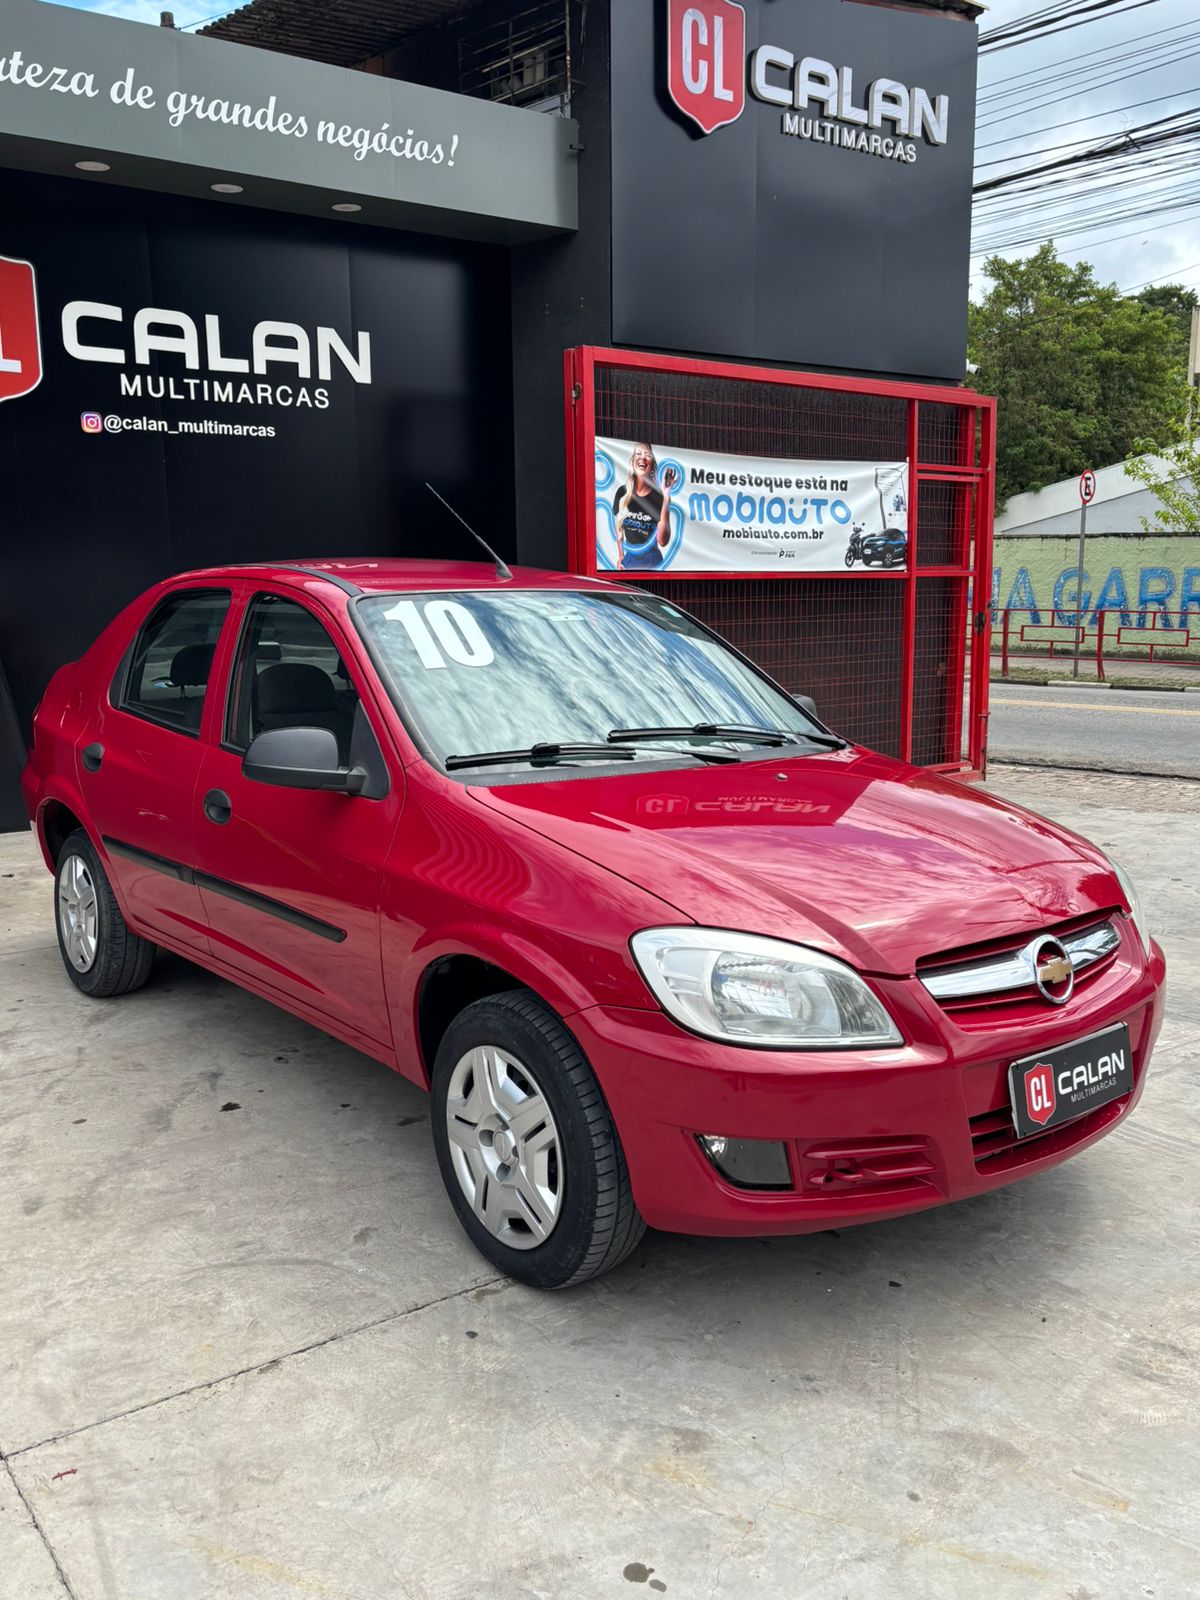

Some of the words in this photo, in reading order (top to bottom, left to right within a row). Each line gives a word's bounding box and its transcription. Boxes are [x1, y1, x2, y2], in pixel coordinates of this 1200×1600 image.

[682, 8, 733, 102] CL
[110, 68, 156, 109] de
[166, 91, 308, 137] grandes
[317, 123, 459, 167] negócios!
[753, 45, 949, 145] CALAN
[783, 112, 917, 163] MULTIMARCAS
[61, 301, 372, 384] CALAN
[120, 373, 330, 409] MULTIMARCAS
[103, 414, 276, 438] @calan_multimarcas
[691, 468, 726, 485] Meu
[729, 474, 793, 493] estoque
[795, 477, 827, 490] está
[830, 479, 848, 491] na
[722, 527, 824, 540] mobiauto.com.br
[382, 600, 495, 670] 10
[1030, 1074, 1052, 1112] CL
[1058, 1049, 1125, 1095] CALAN
[1070, 1077, 1117, 1103] MULTIMARCAS
